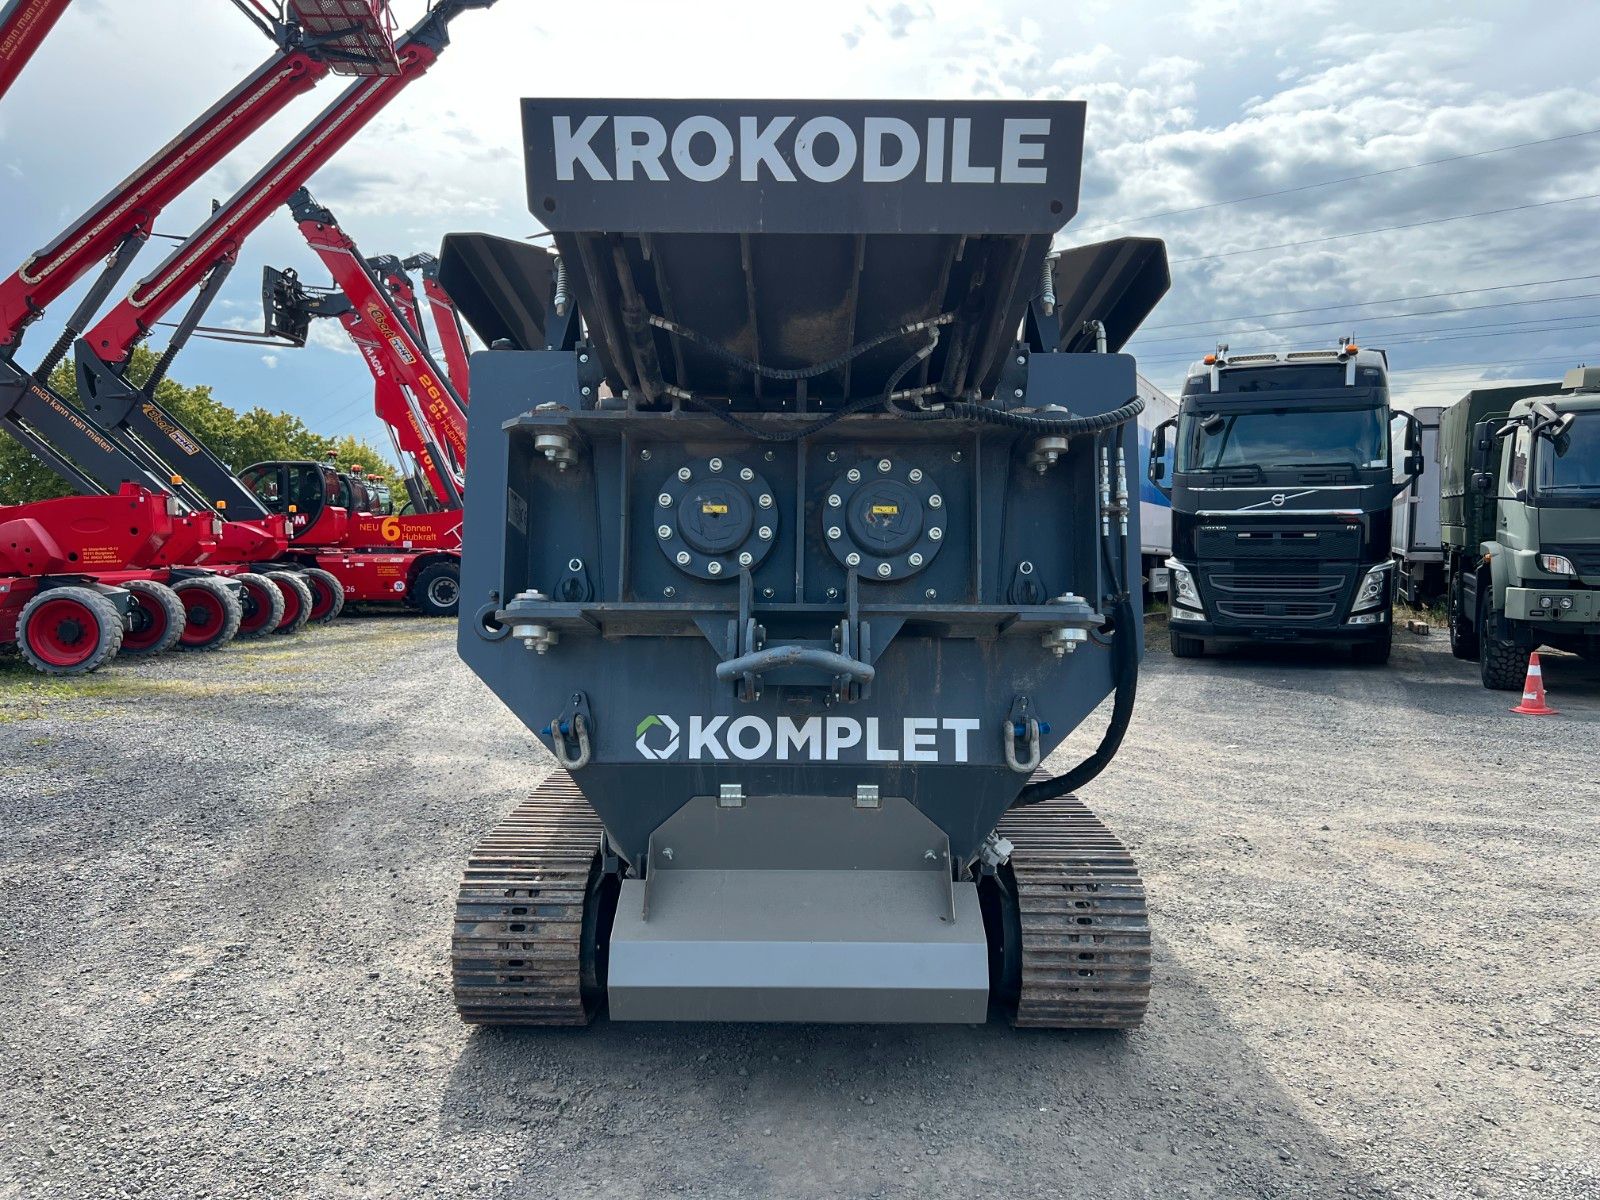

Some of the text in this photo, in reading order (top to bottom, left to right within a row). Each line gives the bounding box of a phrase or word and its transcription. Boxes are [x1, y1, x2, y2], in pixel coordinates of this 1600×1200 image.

[17, 7, 35, 29] man
[552, 115, 1051, 184] KROKODILE
[364, 346, 386, 377] MAGNI
[419, 374, 448, 415] 26m
[31, 385, 114, 454] mich kann man mieten!
[360, 516, 432, 541] NEU 6 Tonnen
[402, 533, 437, 541] Hubkraft
[688, 715, 980, 762] KOMPLET
